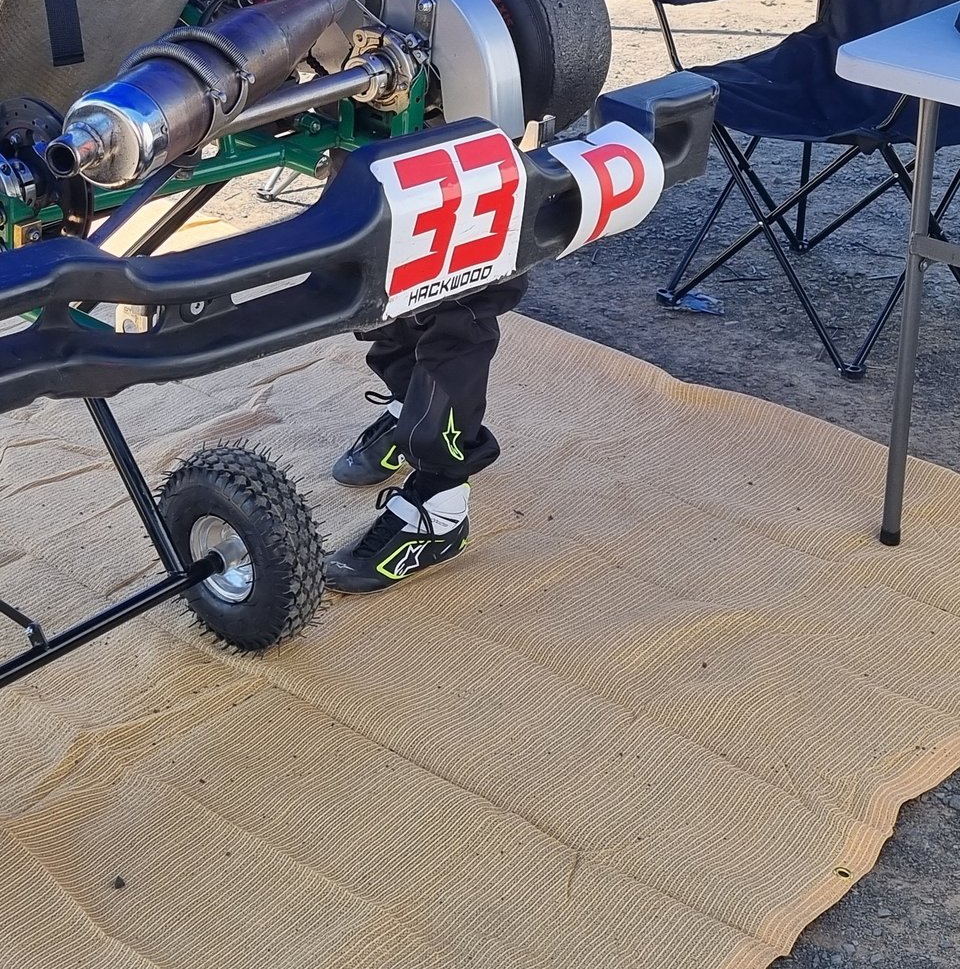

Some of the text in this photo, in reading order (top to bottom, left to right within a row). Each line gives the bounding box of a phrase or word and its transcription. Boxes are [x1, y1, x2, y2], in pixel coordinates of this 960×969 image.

[389, 132, 520, 297] 33
[580, 143, 645, 244] P
[408, 265, 493, 307] HACKWOOD
